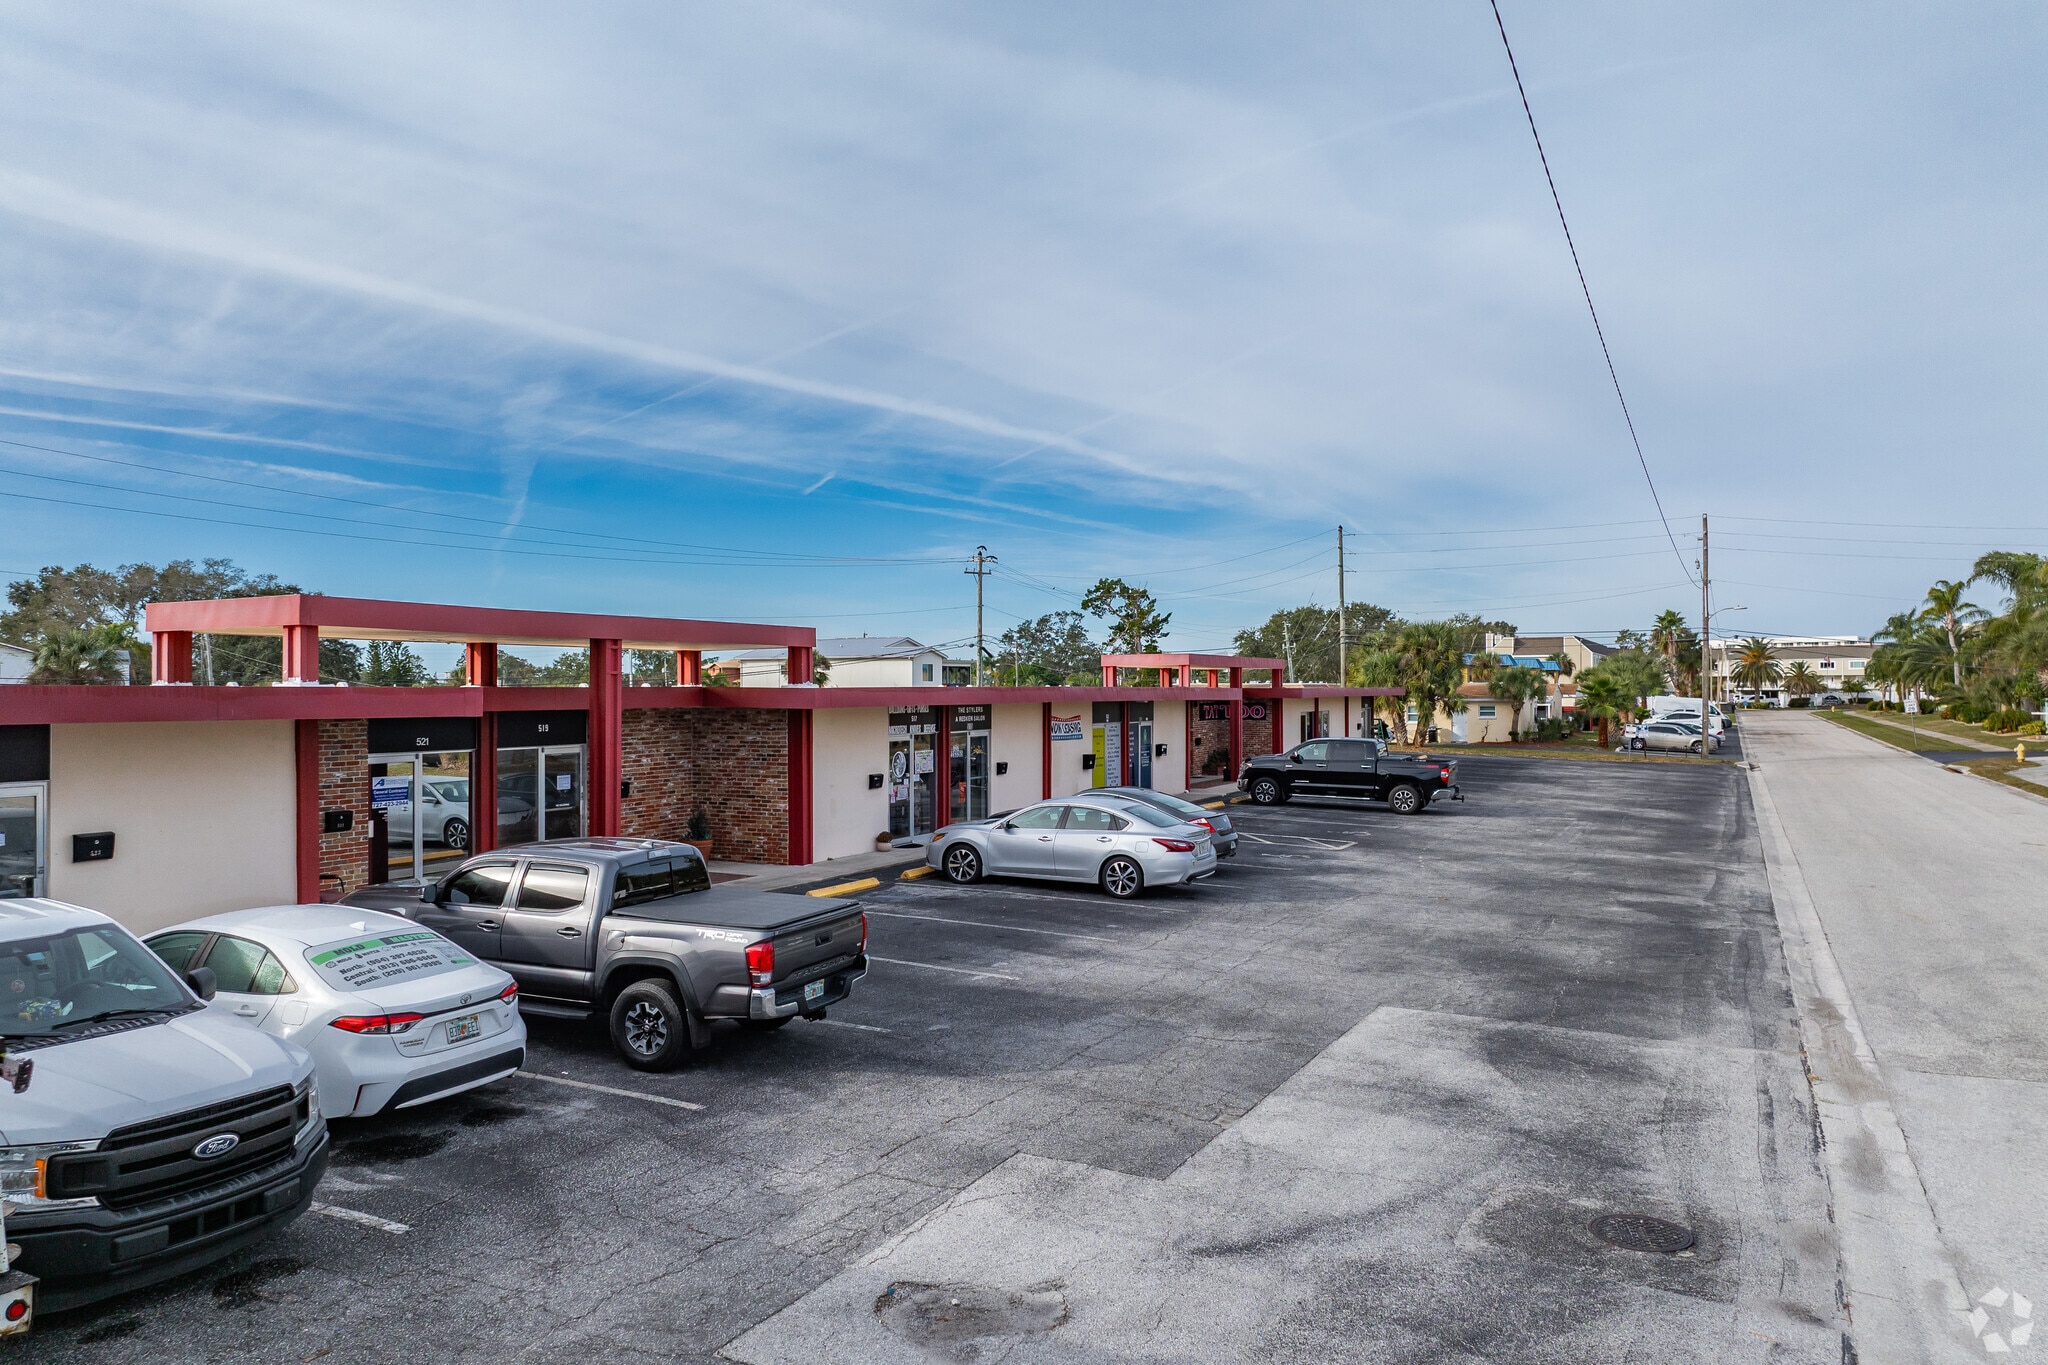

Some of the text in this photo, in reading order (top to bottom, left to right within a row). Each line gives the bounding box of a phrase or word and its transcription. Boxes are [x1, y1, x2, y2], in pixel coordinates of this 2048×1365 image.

[538, 724, 549, 732] 519
[416, 738, 430, 746] 521
[696, 928, 725, 940] TRD
[334, 944, 366, 956] MOLD
[339, 963, 366, 975] North:
[794, 956, 846, 980] TACOMA
[354, 974, 382, 987] South:
[206, 1139, 230, 1154] Ford
